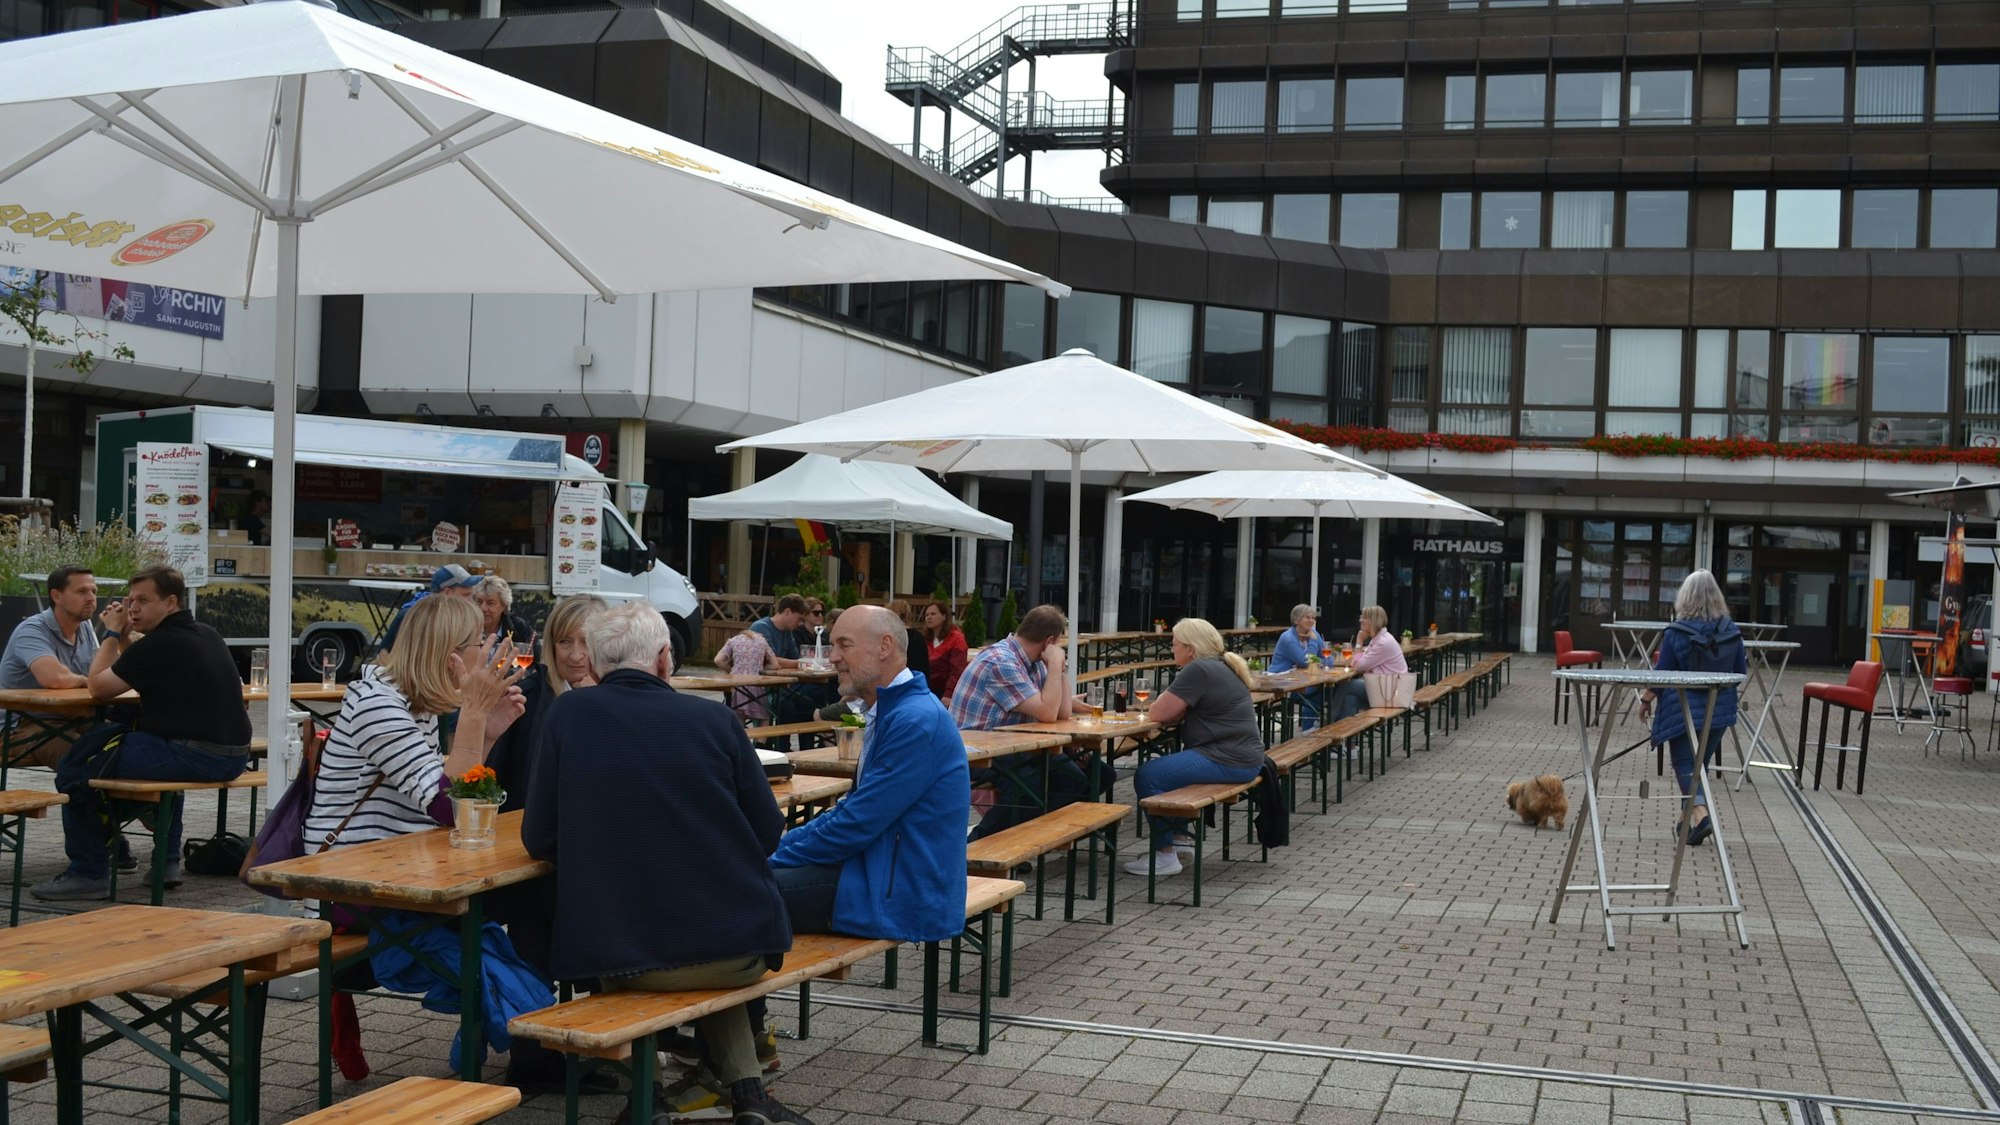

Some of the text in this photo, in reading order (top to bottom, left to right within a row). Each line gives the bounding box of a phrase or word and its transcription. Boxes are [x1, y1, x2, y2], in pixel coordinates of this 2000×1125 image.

[156, 313, 221, 333] SANKT AUGUSTIN
[149, 446, 203, 464] Knödelfein
[1413, 538, 1503, 554] RATHAUS
